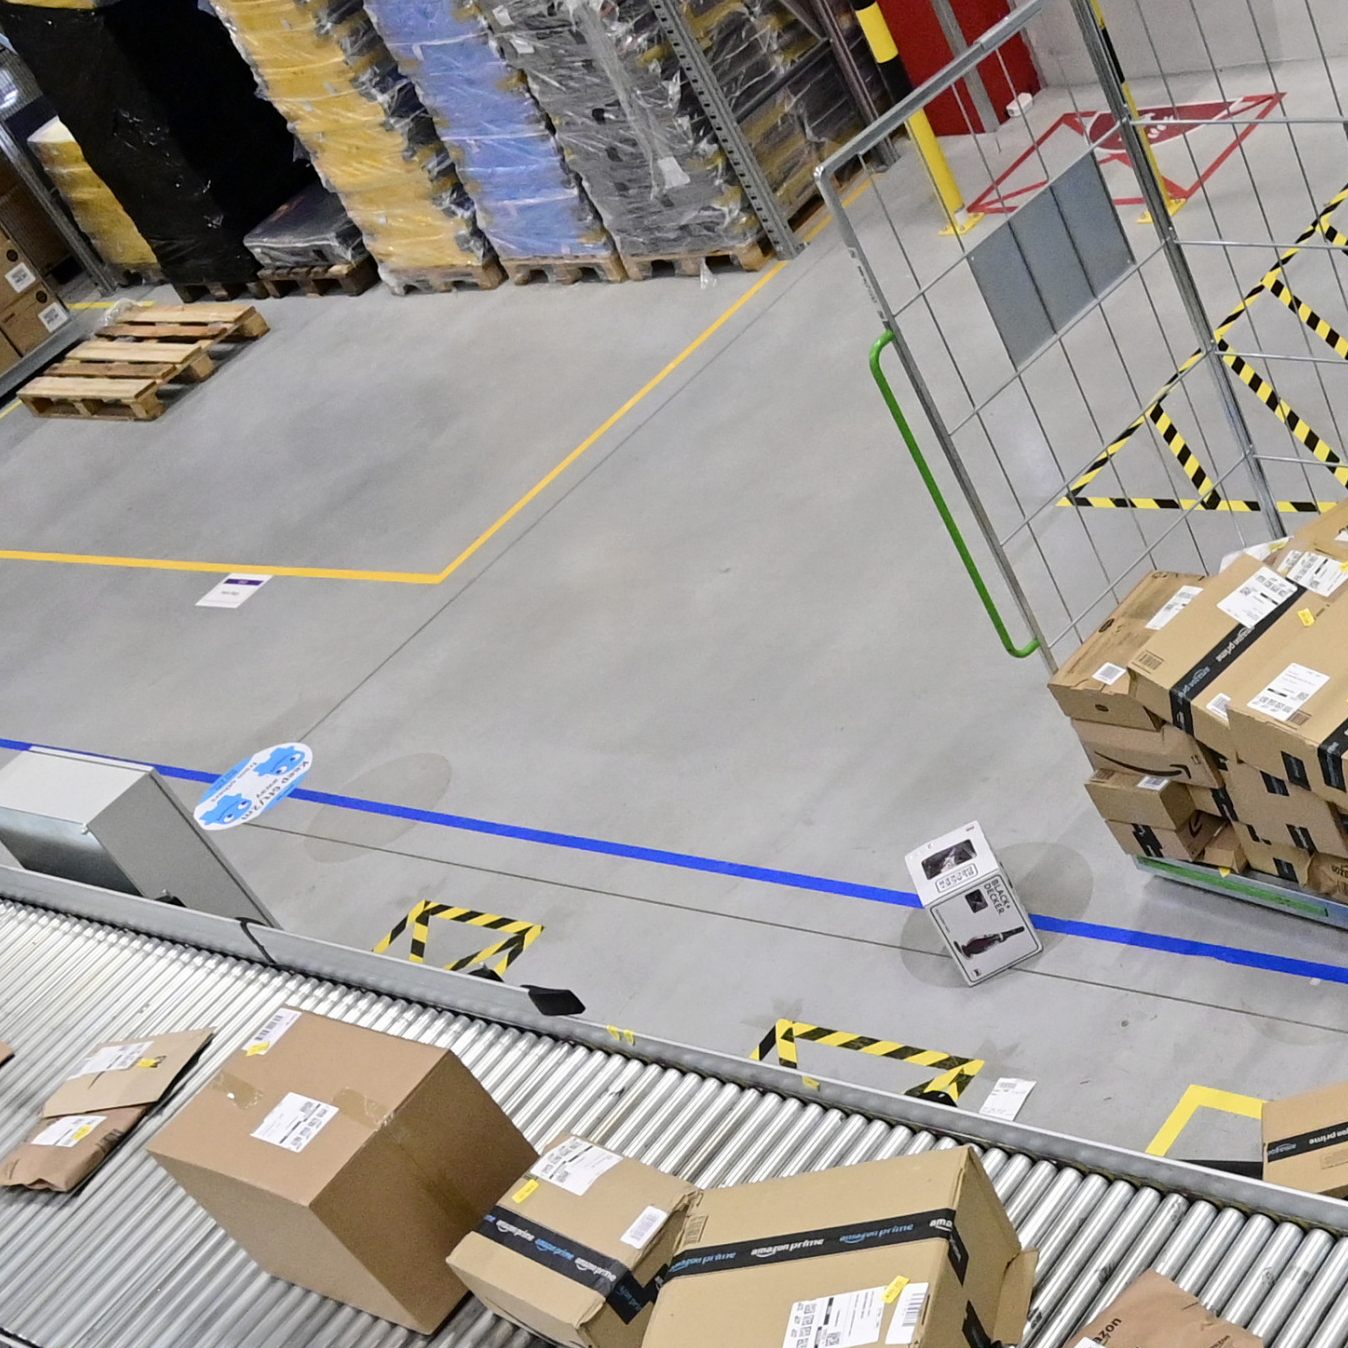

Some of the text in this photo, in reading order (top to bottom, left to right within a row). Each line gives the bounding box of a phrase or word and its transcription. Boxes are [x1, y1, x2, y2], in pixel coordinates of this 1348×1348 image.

[983, 883, 1006, 914] DECKER
[990, 878, 1011, 910] BLACK+
[1308, 1131, 1337, 1145] prime
[838, 1223, 914, 1244] amazon prime
[701, 1251, 737, 1265] prime
[750, 1237, 825, 1259] amazon prime
[1091, 1316, 1123, 1347] azon
